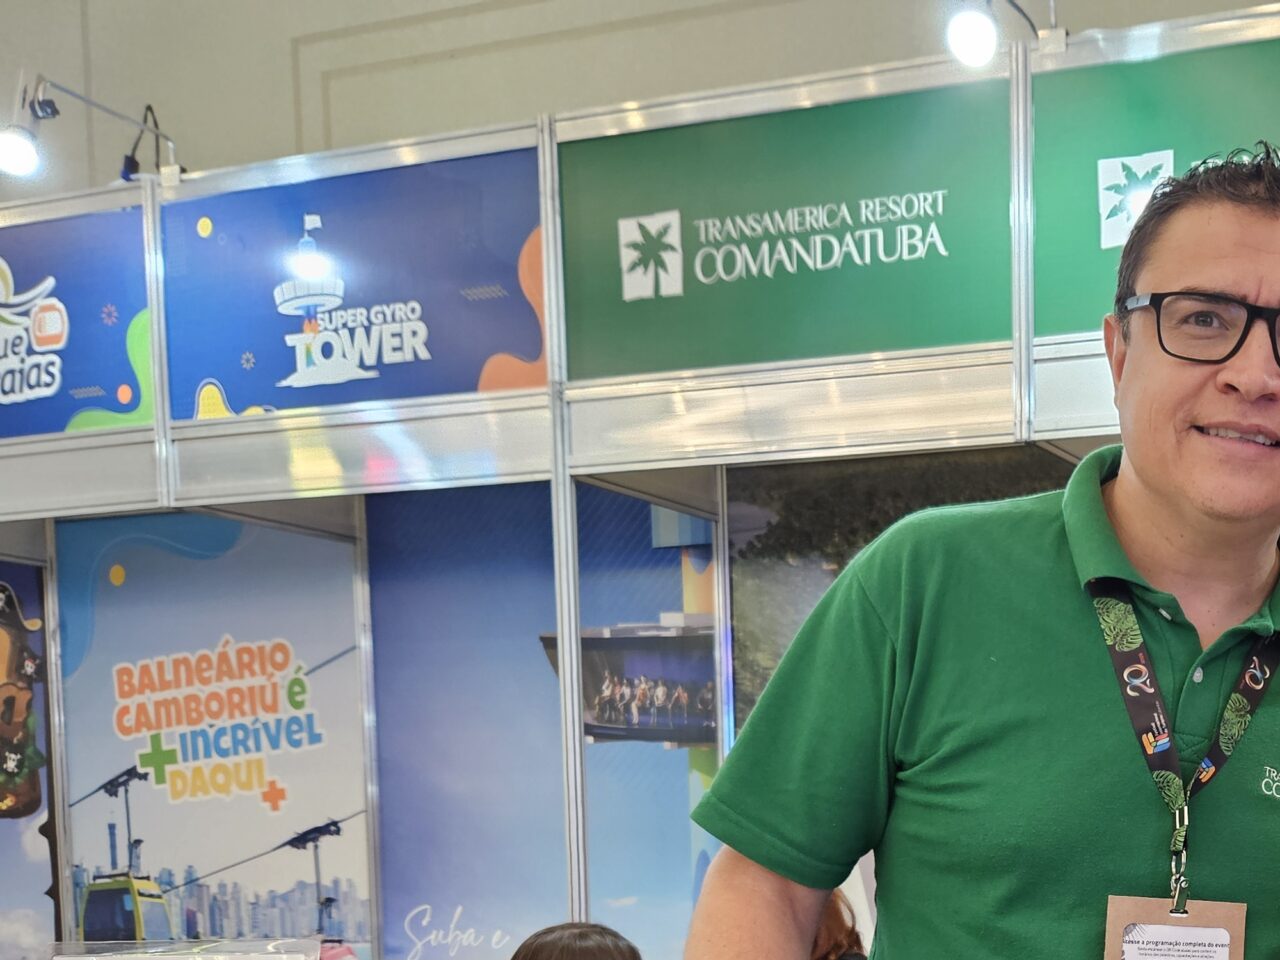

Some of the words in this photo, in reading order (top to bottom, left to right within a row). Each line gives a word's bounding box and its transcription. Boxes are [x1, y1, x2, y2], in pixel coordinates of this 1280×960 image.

[694, 202, 853, 244] TRANSAMERICA
[859, 189, 948, 224] RESORT
[694, 222, 949, 285] COMANDATUBA
[316, 307, 369, 332] SUPER
[370, 300, 422, 326] GYRO
[284, 320, 433, 372] TOWER
[168, 758, 266, 801] DAQUI
[1146, 940, 1181, 948] programação
